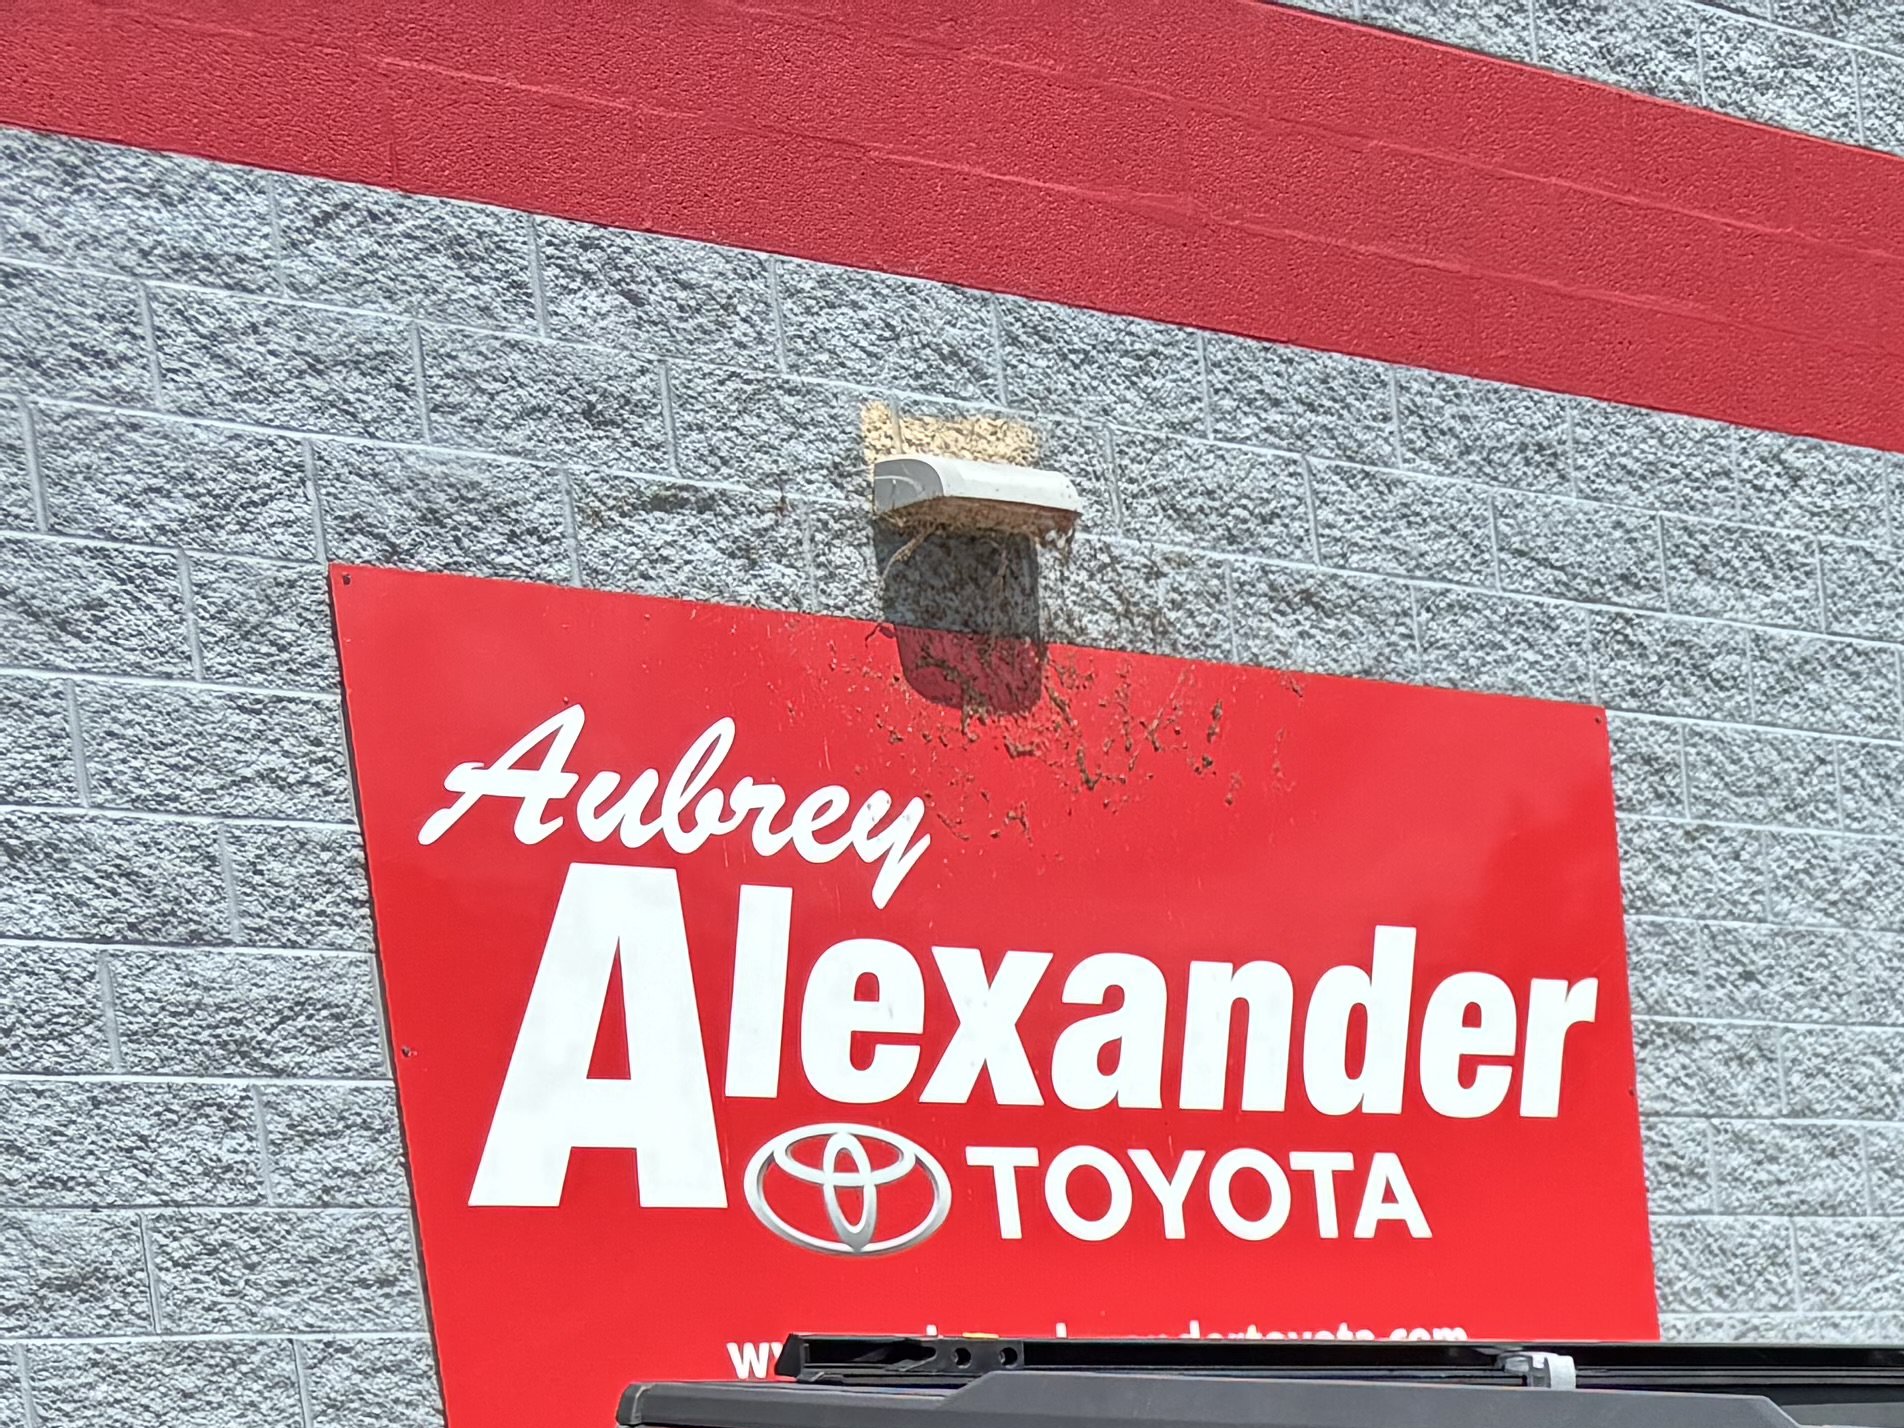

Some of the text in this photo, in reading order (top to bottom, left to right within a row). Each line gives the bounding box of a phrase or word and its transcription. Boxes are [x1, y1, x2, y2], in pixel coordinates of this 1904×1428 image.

[418, 703, 932, 907] Aubrey
[467, 863, 1600, 1210] Alexander
[965, 1143, 1433, 1243] TOYOTA
